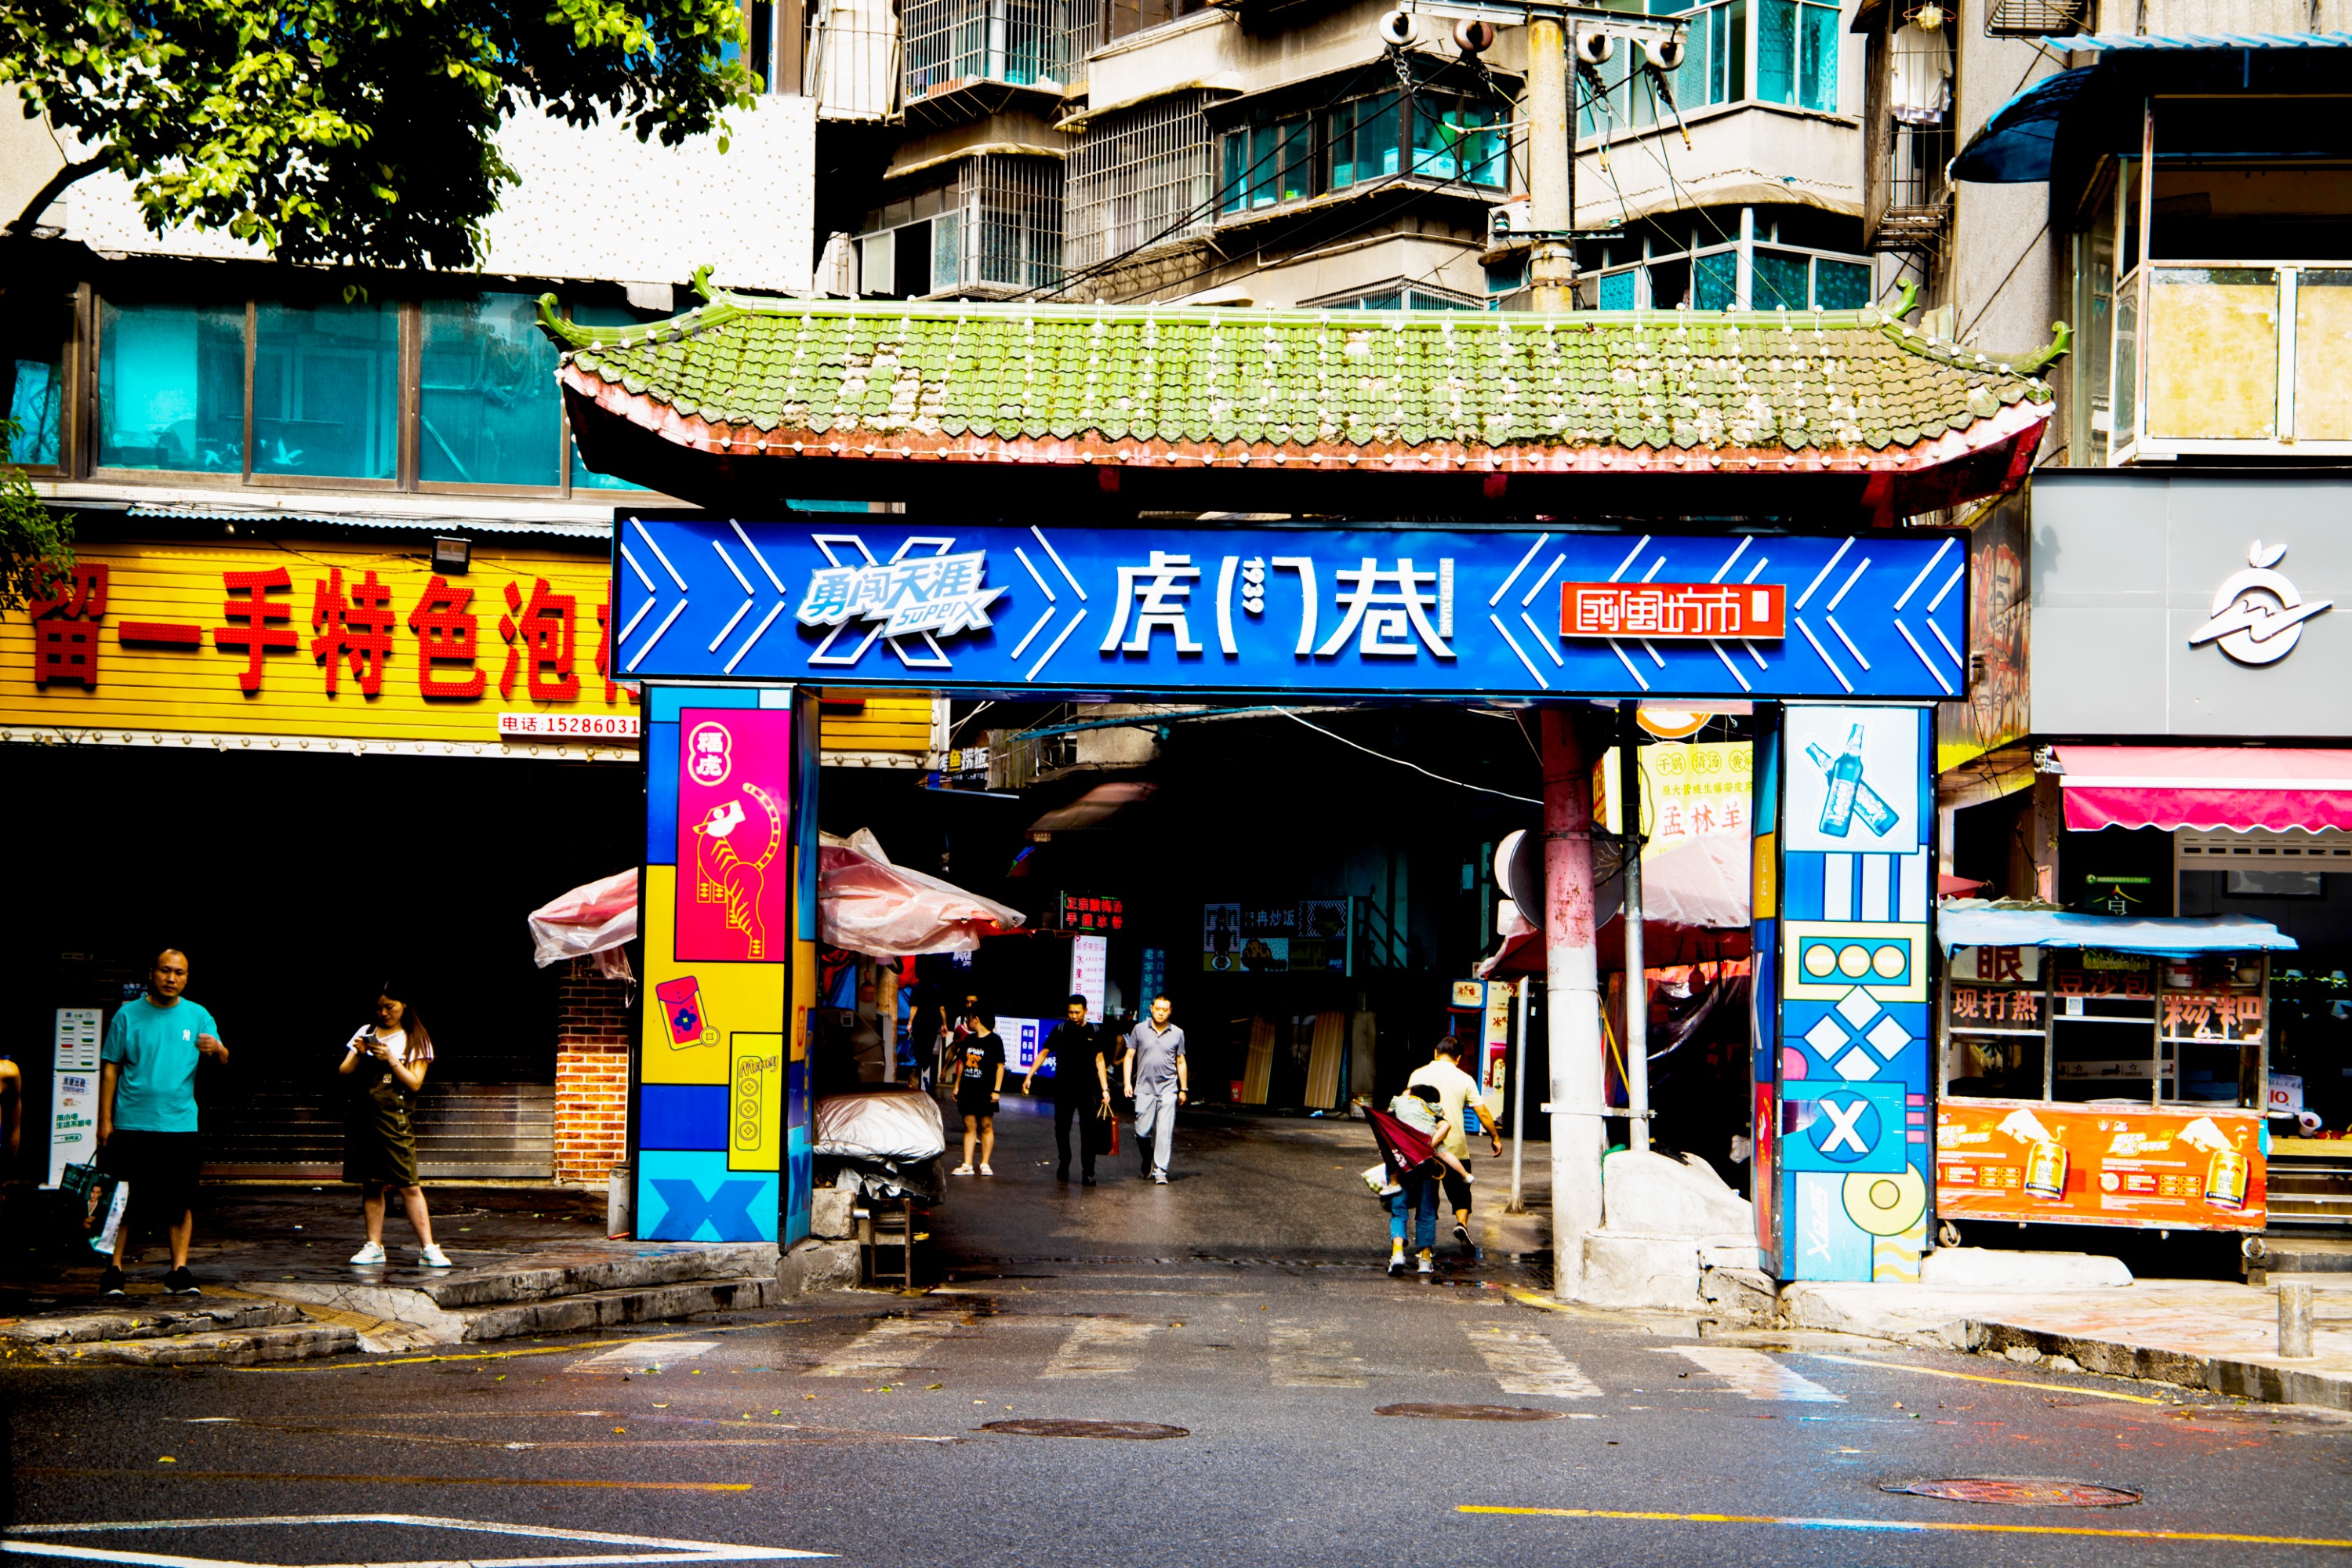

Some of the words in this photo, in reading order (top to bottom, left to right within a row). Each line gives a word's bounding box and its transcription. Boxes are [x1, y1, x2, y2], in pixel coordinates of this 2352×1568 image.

[807, 559, 975, 618] 勇闯天涯
[1242, 557, 1265, 613] 1939
[1100, 552, 1455, 657] 虎门巷
[696, 731, 723, 778] 福虎
[1695, 755, 1719, 769] 清汤
[2056, 968, 2152, 1000] 豆沙包
[1952, 988, 2038, 1022] 现打热
[2162, 991, 2263, 1040] 糍粑
[739, 1055, 779, 1078] Money
[2270, 1089, 2289, 1104] 10
[56, 1113, 78, 1122] 用小电
